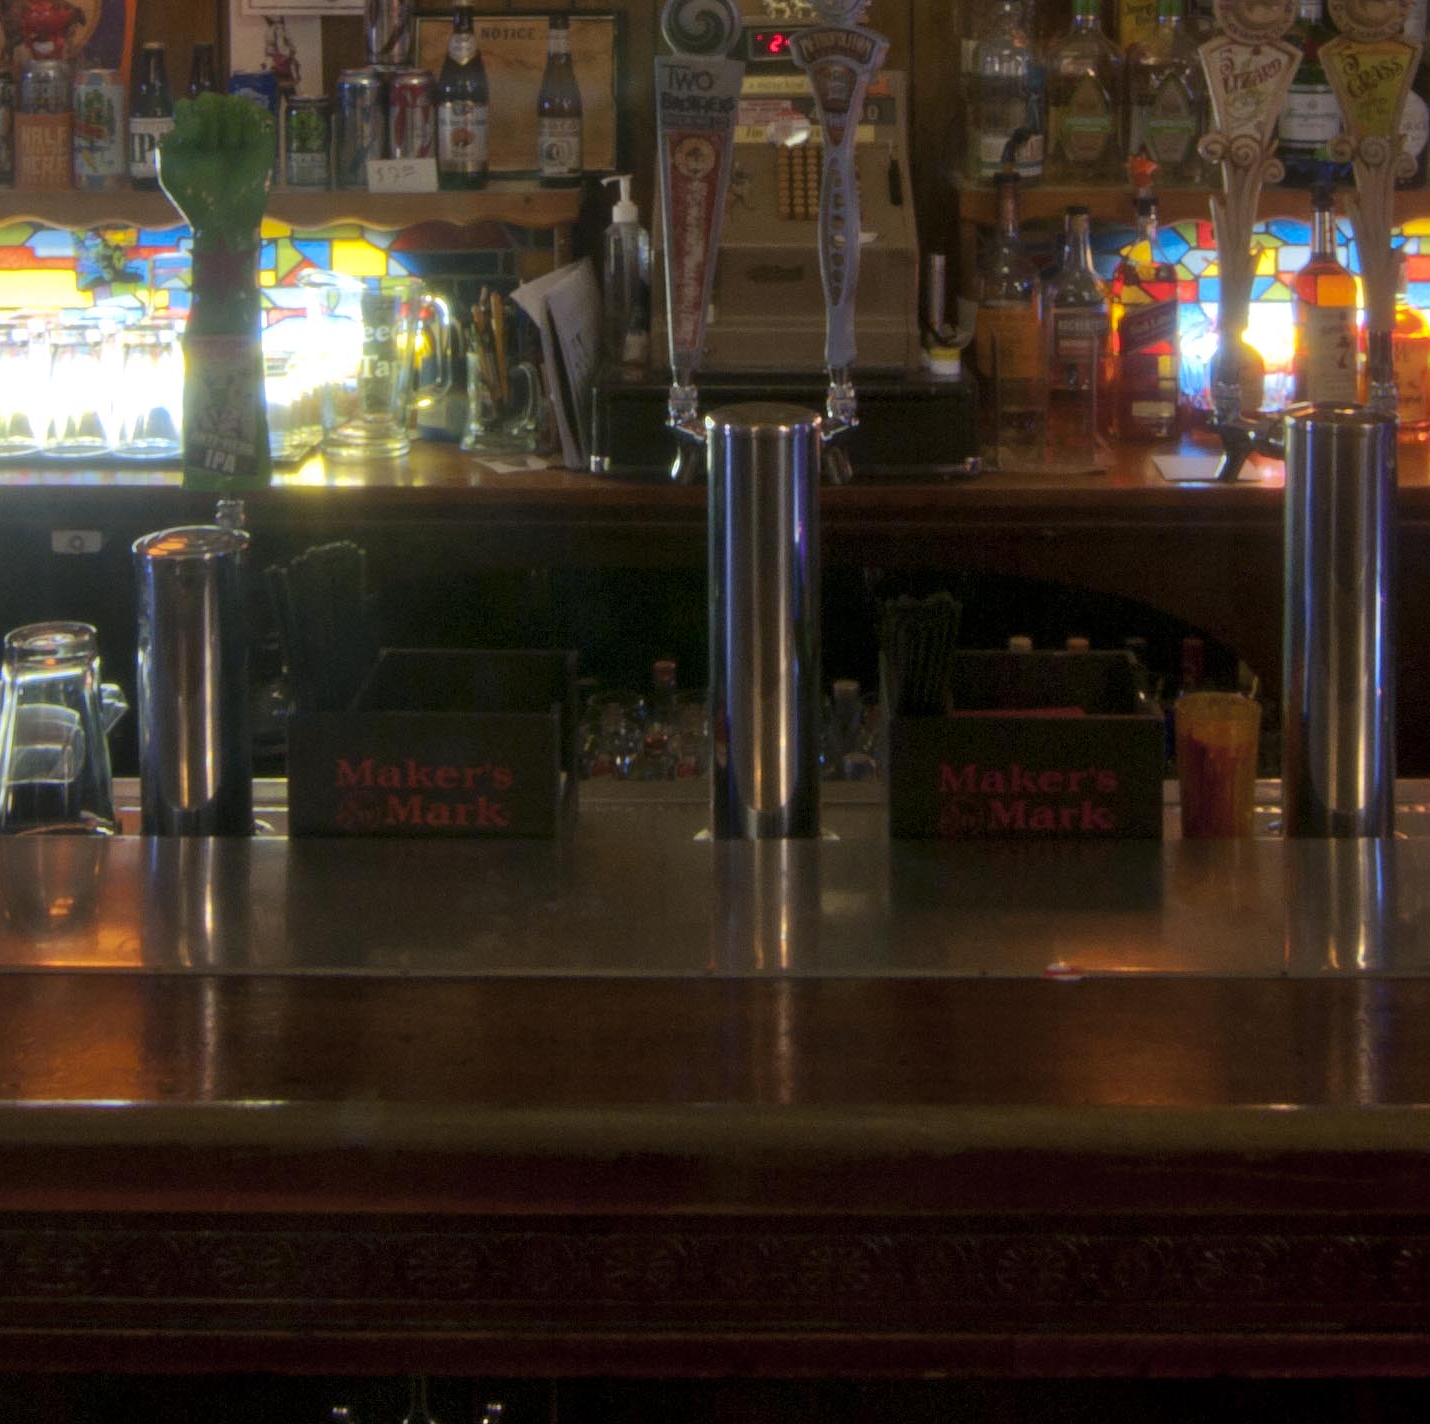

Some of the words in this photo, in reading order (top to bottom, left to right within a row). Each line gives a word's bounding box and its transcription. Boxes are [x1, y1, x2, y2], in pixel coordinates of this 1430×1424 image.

[482, 27, 537, 41] NOTICE
[660, 63, 714, 92] TWO
[1222, 58, 1282, 94] LIZARD
[204, 448, 238, 474] IPA
[334, 754, 515, 790] Maker's
[939, 761, 1119, 793] Maker's
[385, 794, 512, 828] Mark
[990, 799, 1115, 829] Mark
